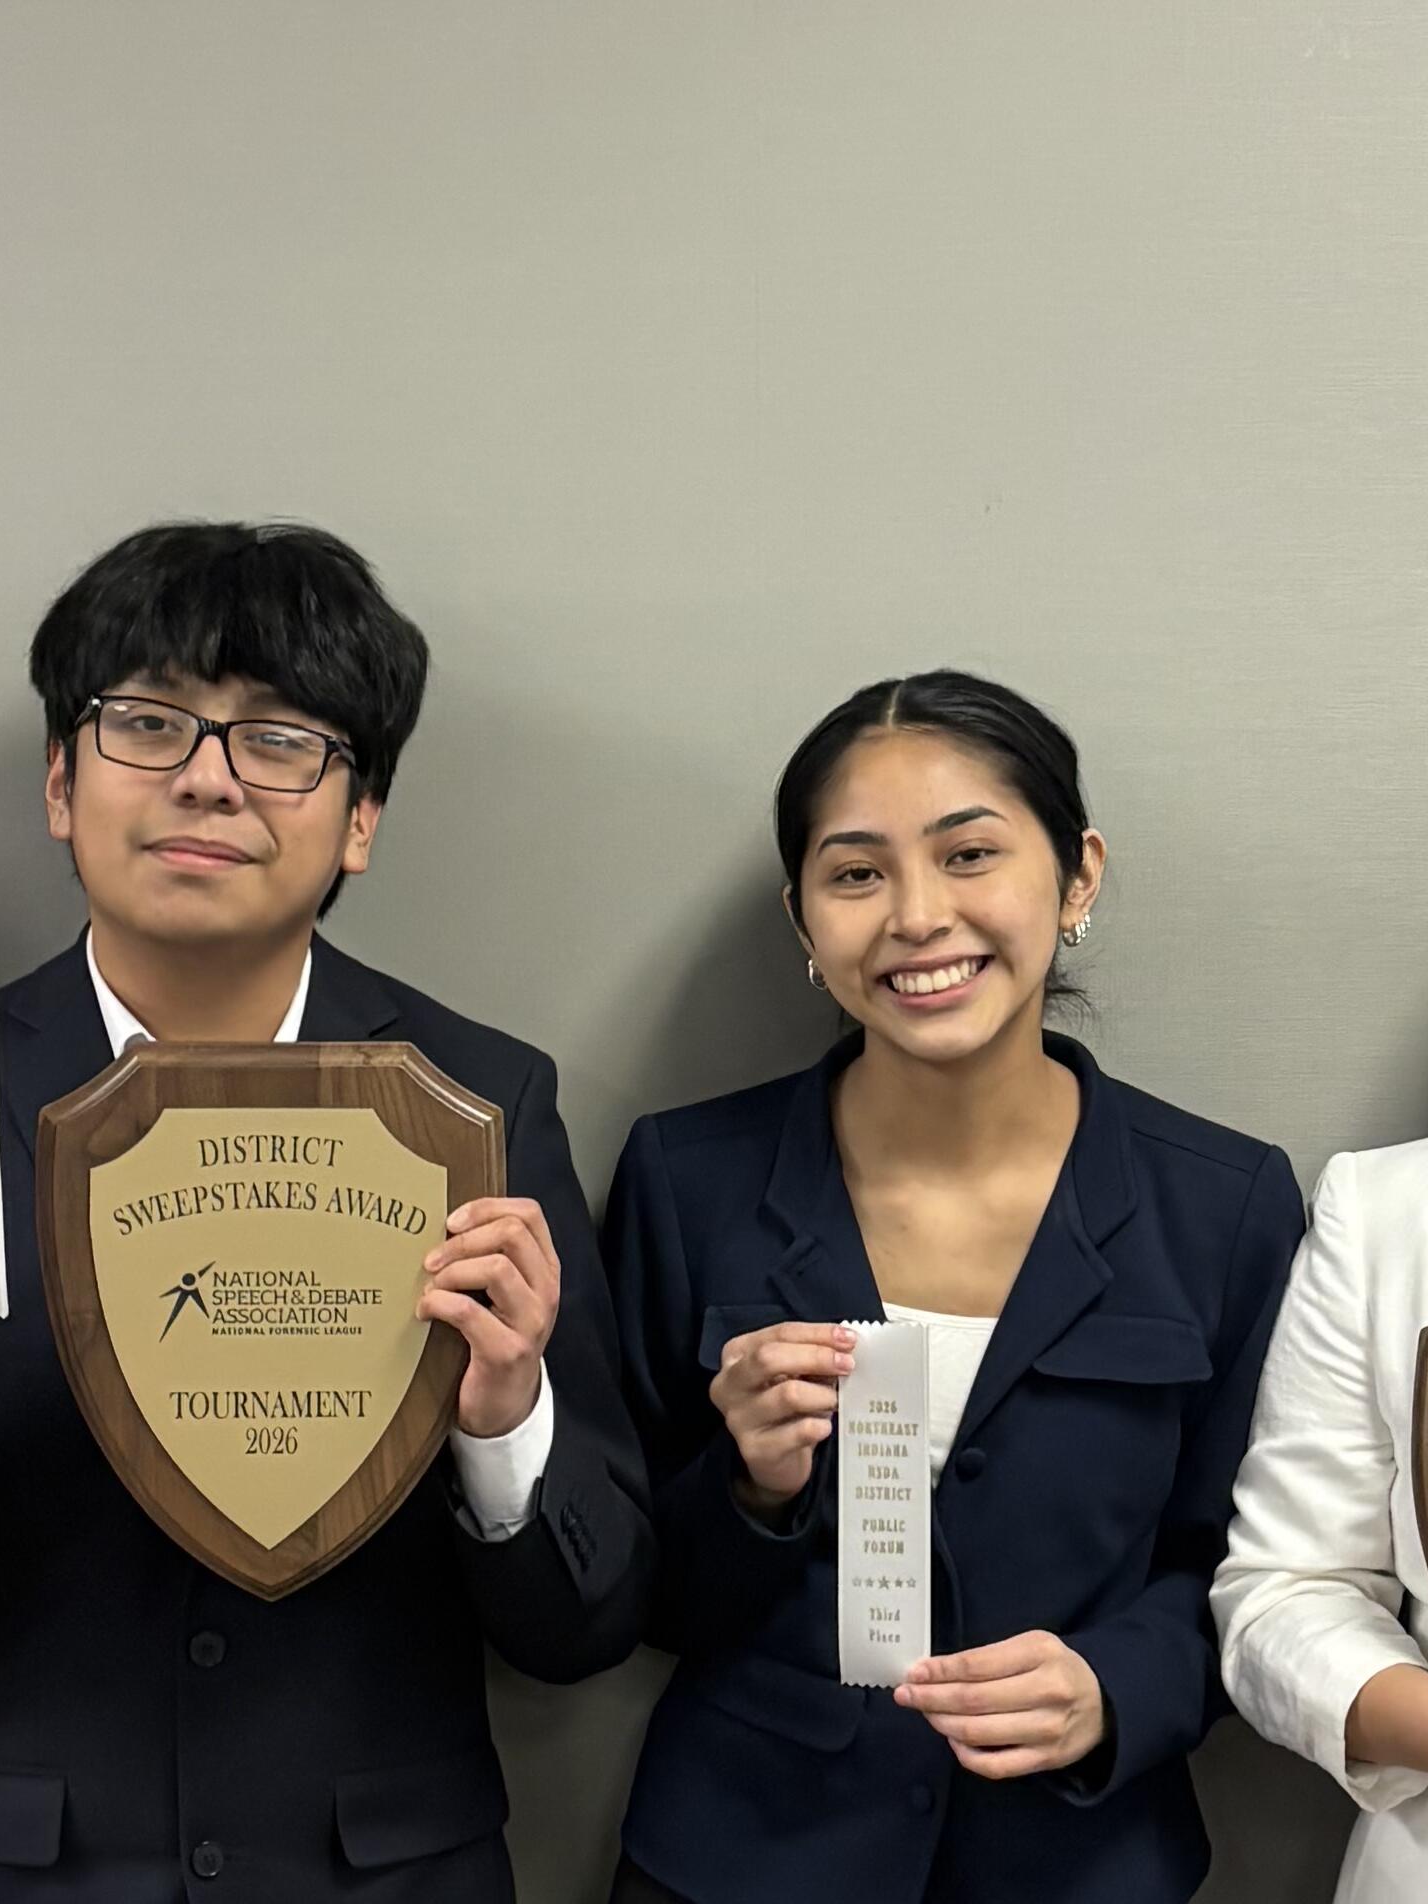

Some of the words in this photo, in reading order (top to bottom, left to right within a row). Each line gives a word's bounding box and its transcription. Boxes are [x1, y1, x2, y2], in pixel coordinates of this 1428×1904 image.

[198, 1134, 344, 1168] DISTRICT
[112, 1181, 318, 1237] SWEEPSTAKES
[325, 1185, 427, 1237] AWARD
[212, 1270, 322, 1287] NATIONAL
[212, 1289, 289, 1307] SPEECH
[308, 1289, 383, 1306] DEBATE
[212, 1307, 349, 1325] ASSOCIATION
[212, 1327, 265, 1336] NATIONAL
[269, 1327, 320, 1336] FORENSIC
[324, 1327, 363, 1336] LEAGUE
[169, 1390, 373, 1420] TOURNAMENT
[848, 1421, 919, 1437] NORTHEAST
[245, 1427, 299, 1456] 2026
[858, 1443, 909, 1458] INDIANA
[868, 1465, 899, 1480] NSDA
[855, 1488, 912, 1502] DISTRICT
[862, 1519, 906, 1533] PUBLIC
[863, 1540, 905, 1555] FORUM
[869, 1608, 901, 1622] Third
[869, 1629, 901, 1644] Place
